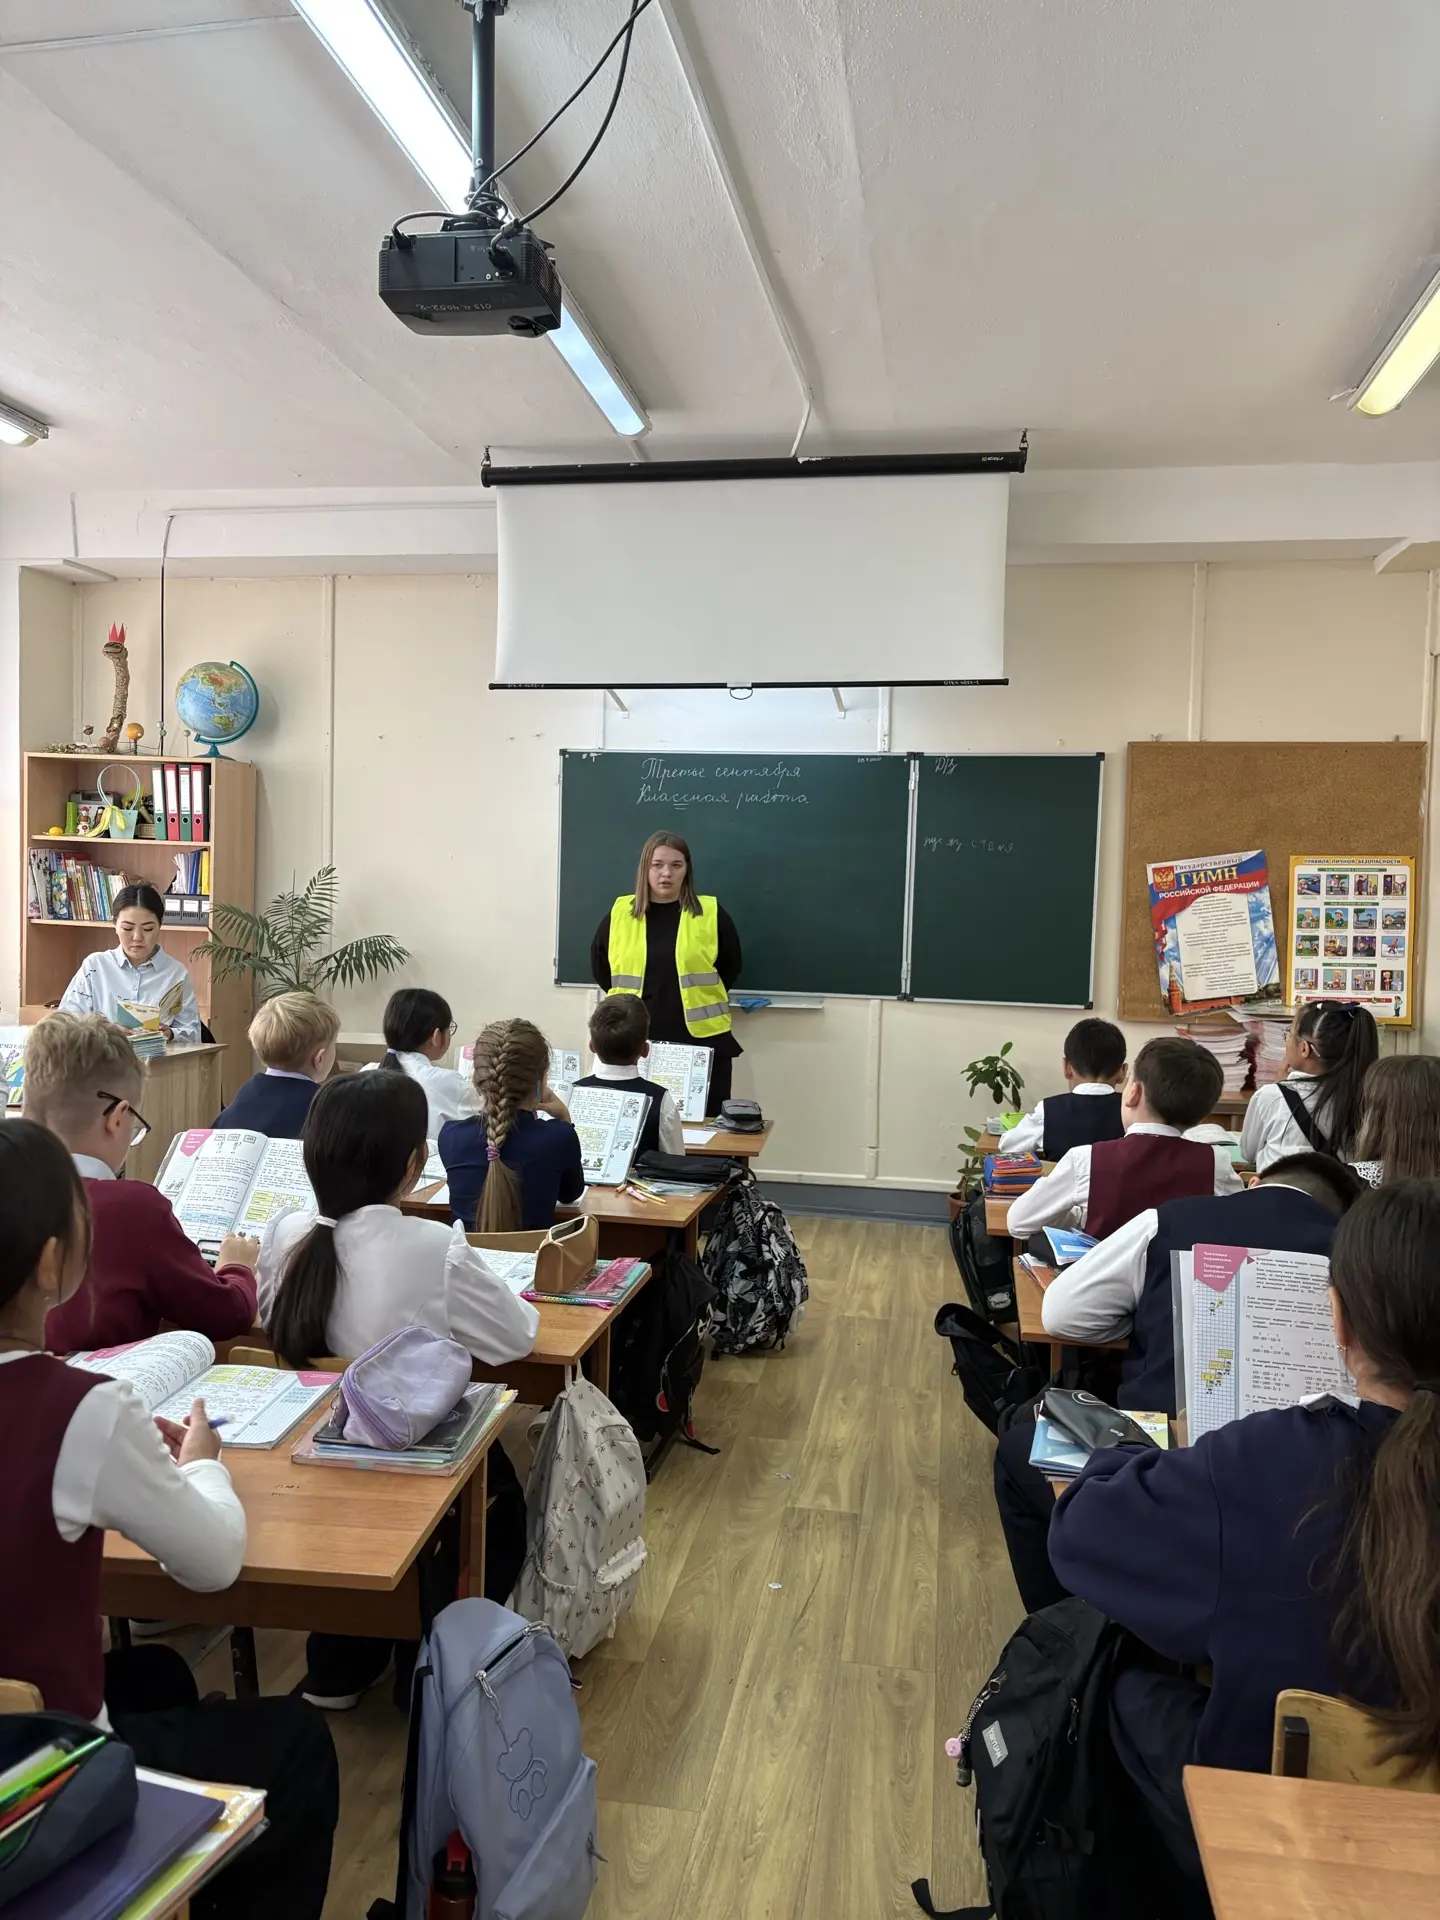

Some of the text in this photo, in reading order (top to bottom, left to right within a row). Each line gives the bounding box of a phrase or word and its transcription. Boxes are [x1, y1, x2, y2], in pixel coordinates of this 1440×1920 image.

[641, 758, 801, 791] Третье сентября
[637, 783, 729, 805] Классная
[1175, 857, 1242, 871] Государственный
[1180, 866, 1238, 886] ГИМН
[1159, 881, 1260, 899] РОССИЙСКОЙ ФЕДЕРАЦИИ
